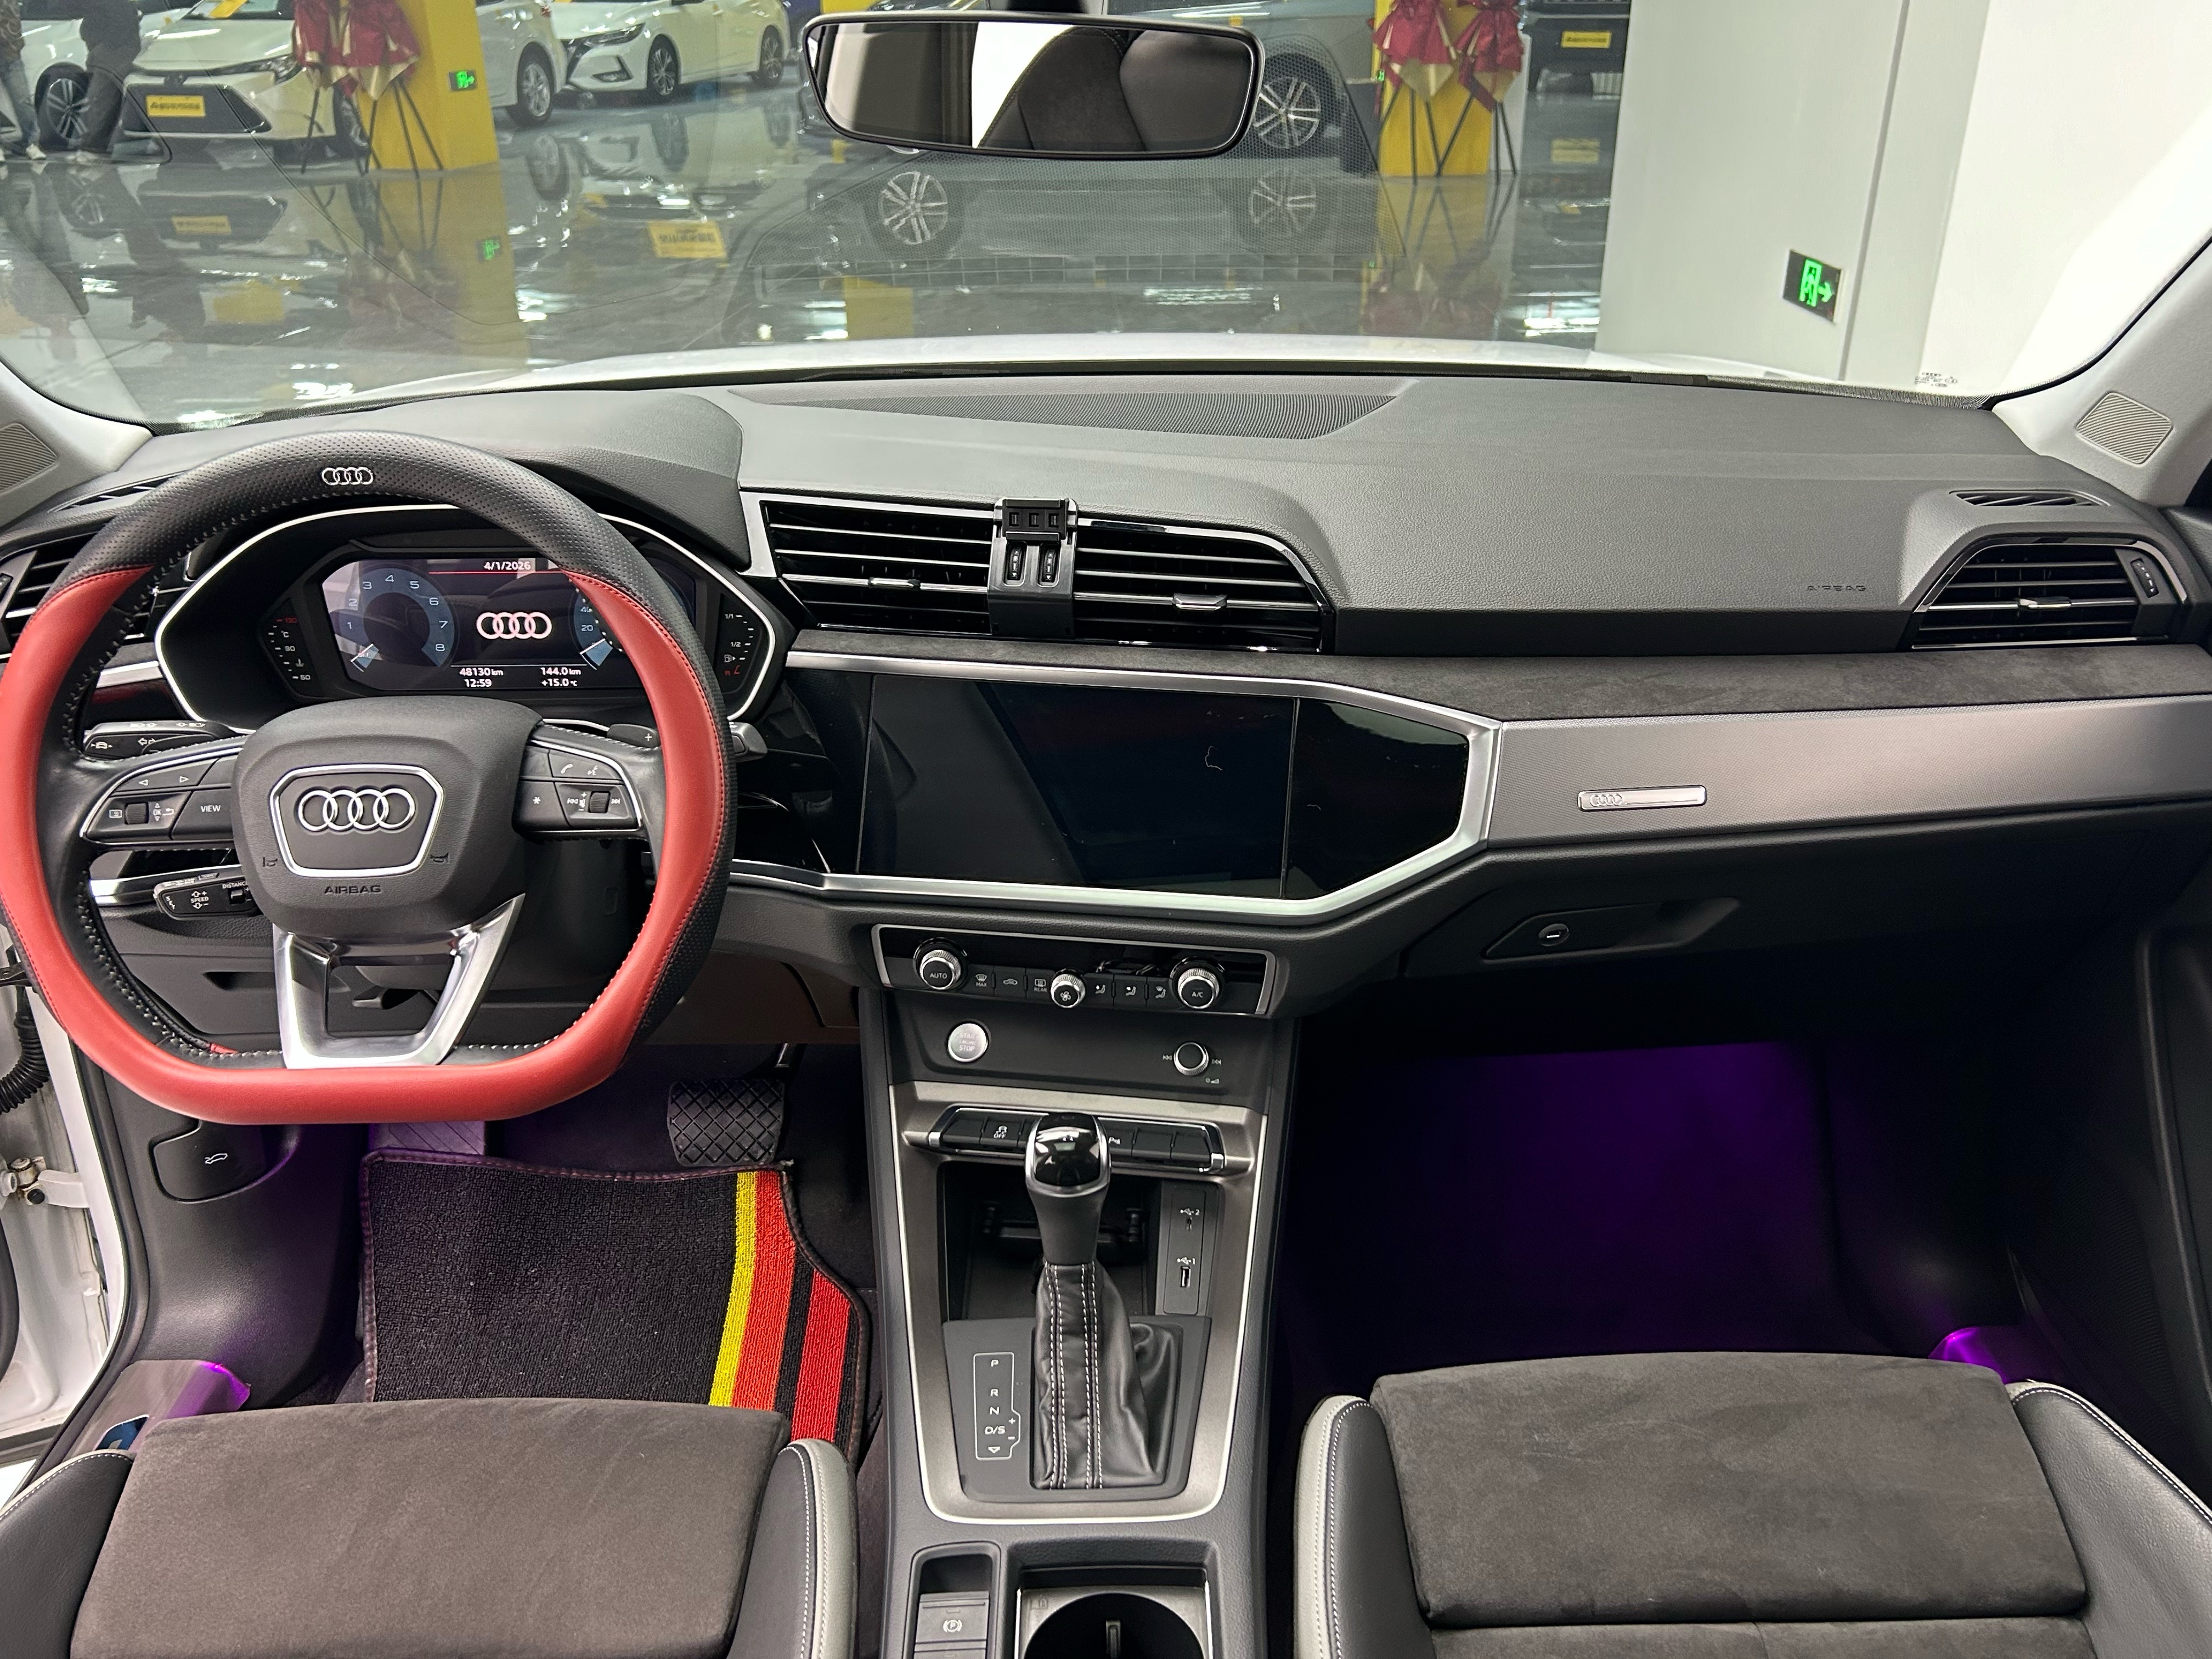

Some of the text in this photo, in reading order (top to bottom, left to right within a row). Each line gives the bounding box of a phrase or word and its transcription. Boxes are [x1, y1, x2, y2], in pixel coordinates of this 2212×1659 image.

[484, 561, 531, 571] 4/1/2026
[385, 574, 394, 583] 4
[363, 581, 373, 589] 3
[410, 580, 420, 589] 5
[348, 598, 357, 607] 2
[429, 597, 439, 606] 6
[347, 622, 353, 630] 1
[439, 620, 448, 629] 7
[435, 643, 445, 652] 8
[459, 667, 491, 676] 48130
[540, 667, 568, 676] 144.0
[464, 678, 492, 687] 12:59
[541, 678, 569, 687] +15.0
[200, 804, 221, 813] VIEW
[324, 884, 382, 894] AIRBAG
[991, 1359, 999, 1367] P
[990, 1389, 998, 1397] R
[989, 1406, 1000, 1415] N
[985, 1425, 1006, 1435] D/S
